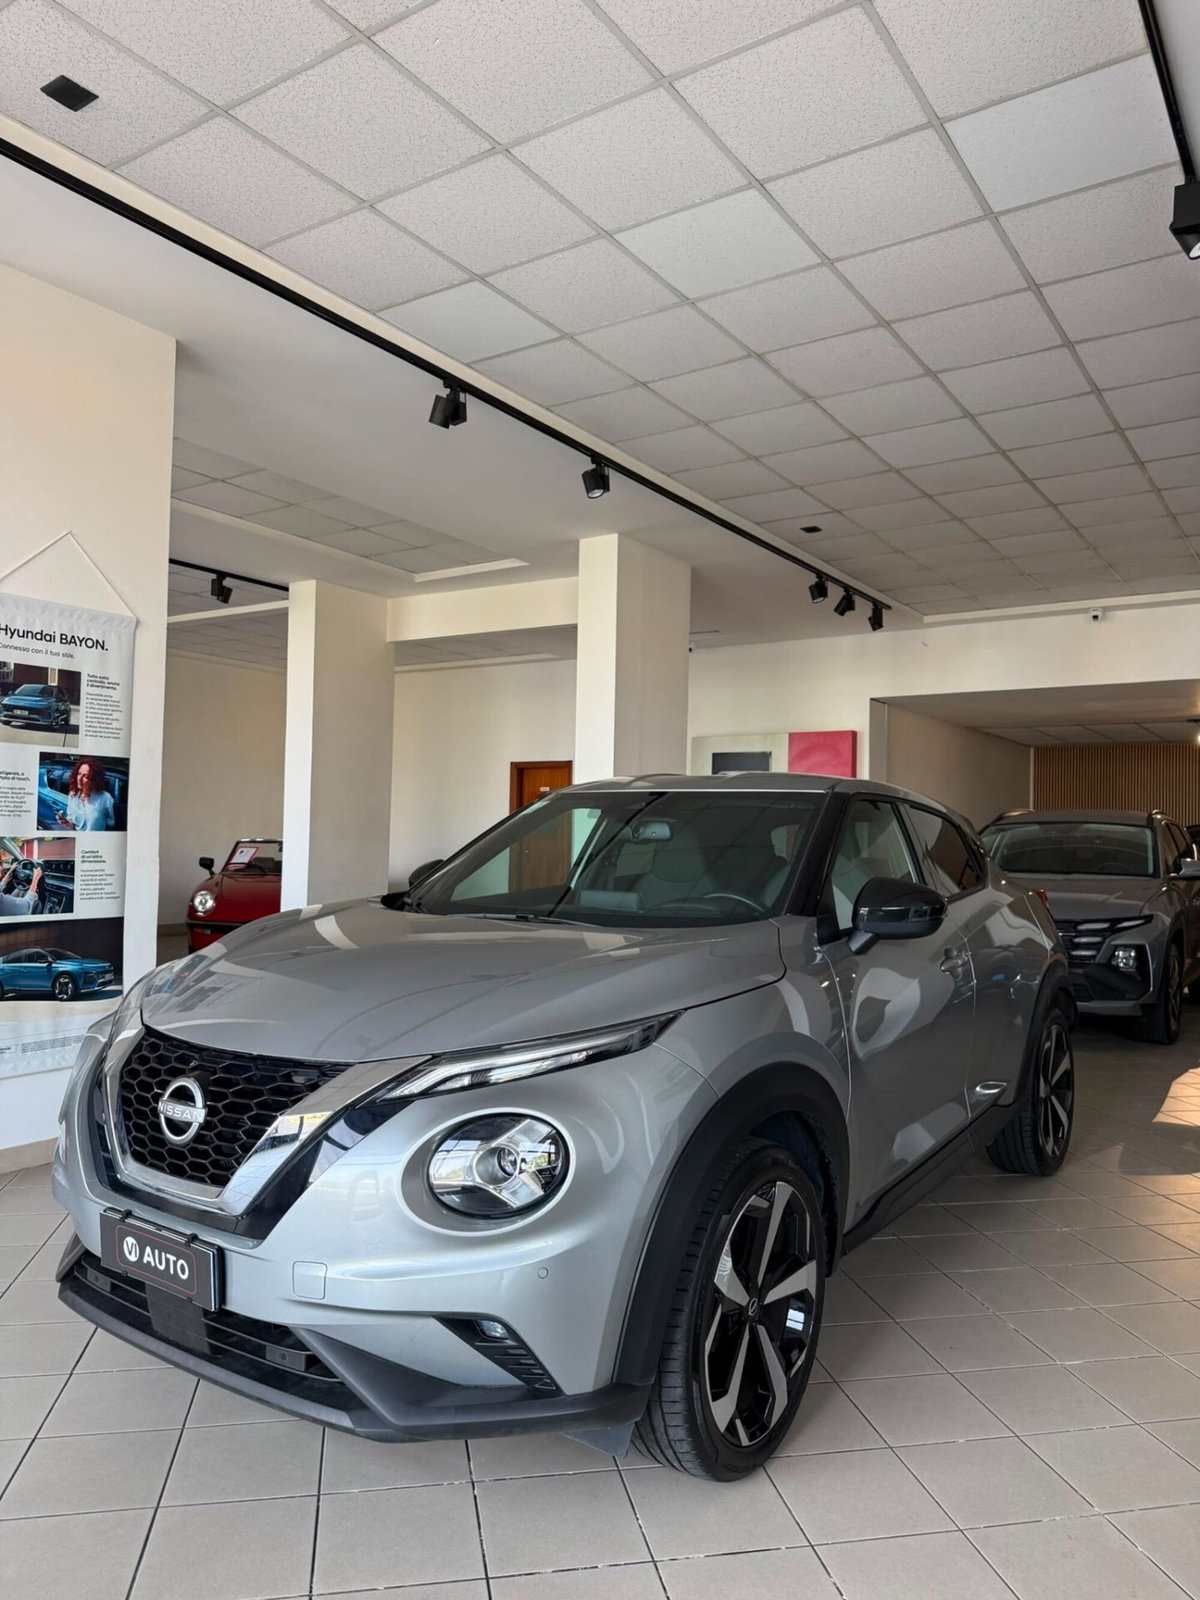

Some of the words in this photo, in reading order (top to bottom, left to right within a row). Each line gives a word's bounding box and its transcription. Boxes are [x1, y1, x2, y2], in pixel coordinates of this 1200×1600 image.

[0, 624, 56, 643] Hyundai
[60, 633, 109, 651] BAYON.
[0, 642, 30, 653] Connesso
[158, 1101, 205, 1121] NISSAN
[143, 1246, 189, 1280] AUTO
